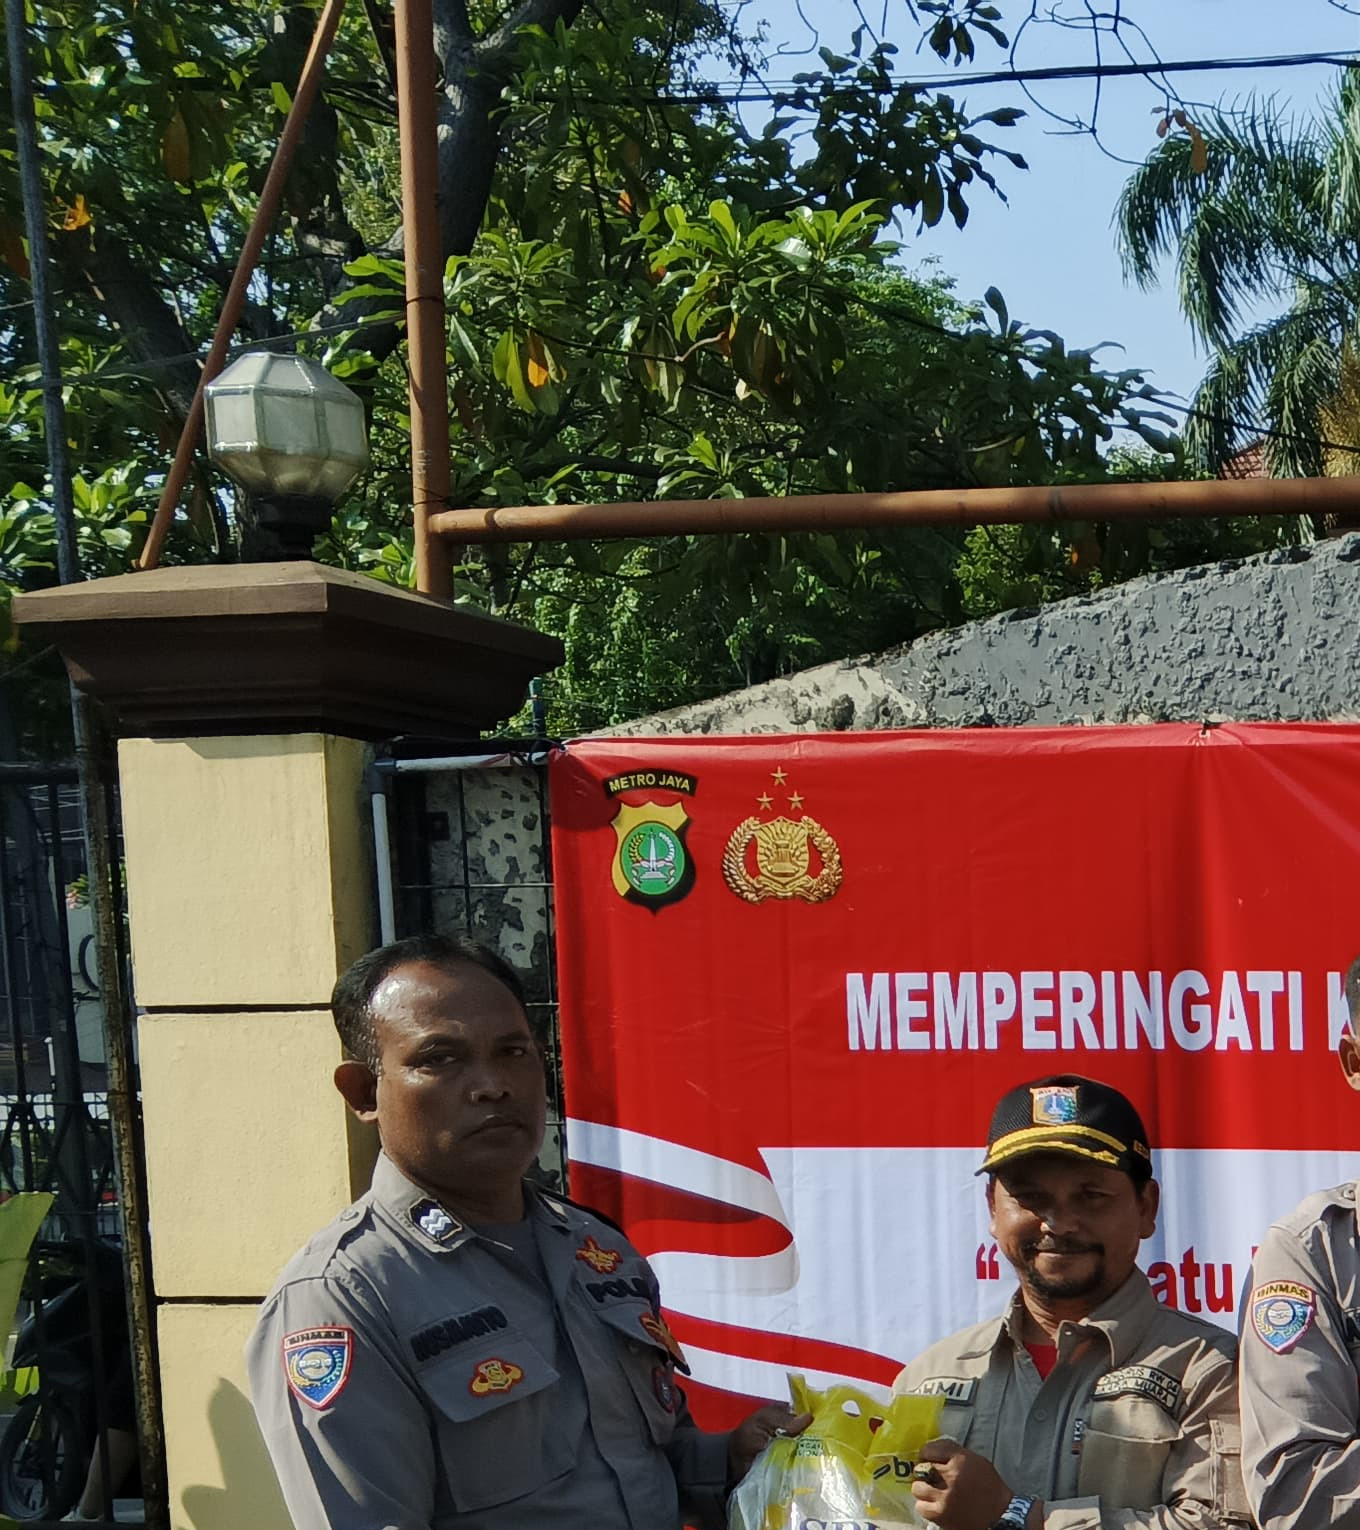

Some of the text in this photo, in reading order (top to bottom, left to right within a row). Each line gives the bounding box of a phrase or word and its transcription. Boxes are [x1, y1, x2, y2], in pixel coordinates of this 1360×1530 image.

[608, 773, 690, 792] METRO JAYA
[846, 970, 1303, 1051] MEMPERINGATI
